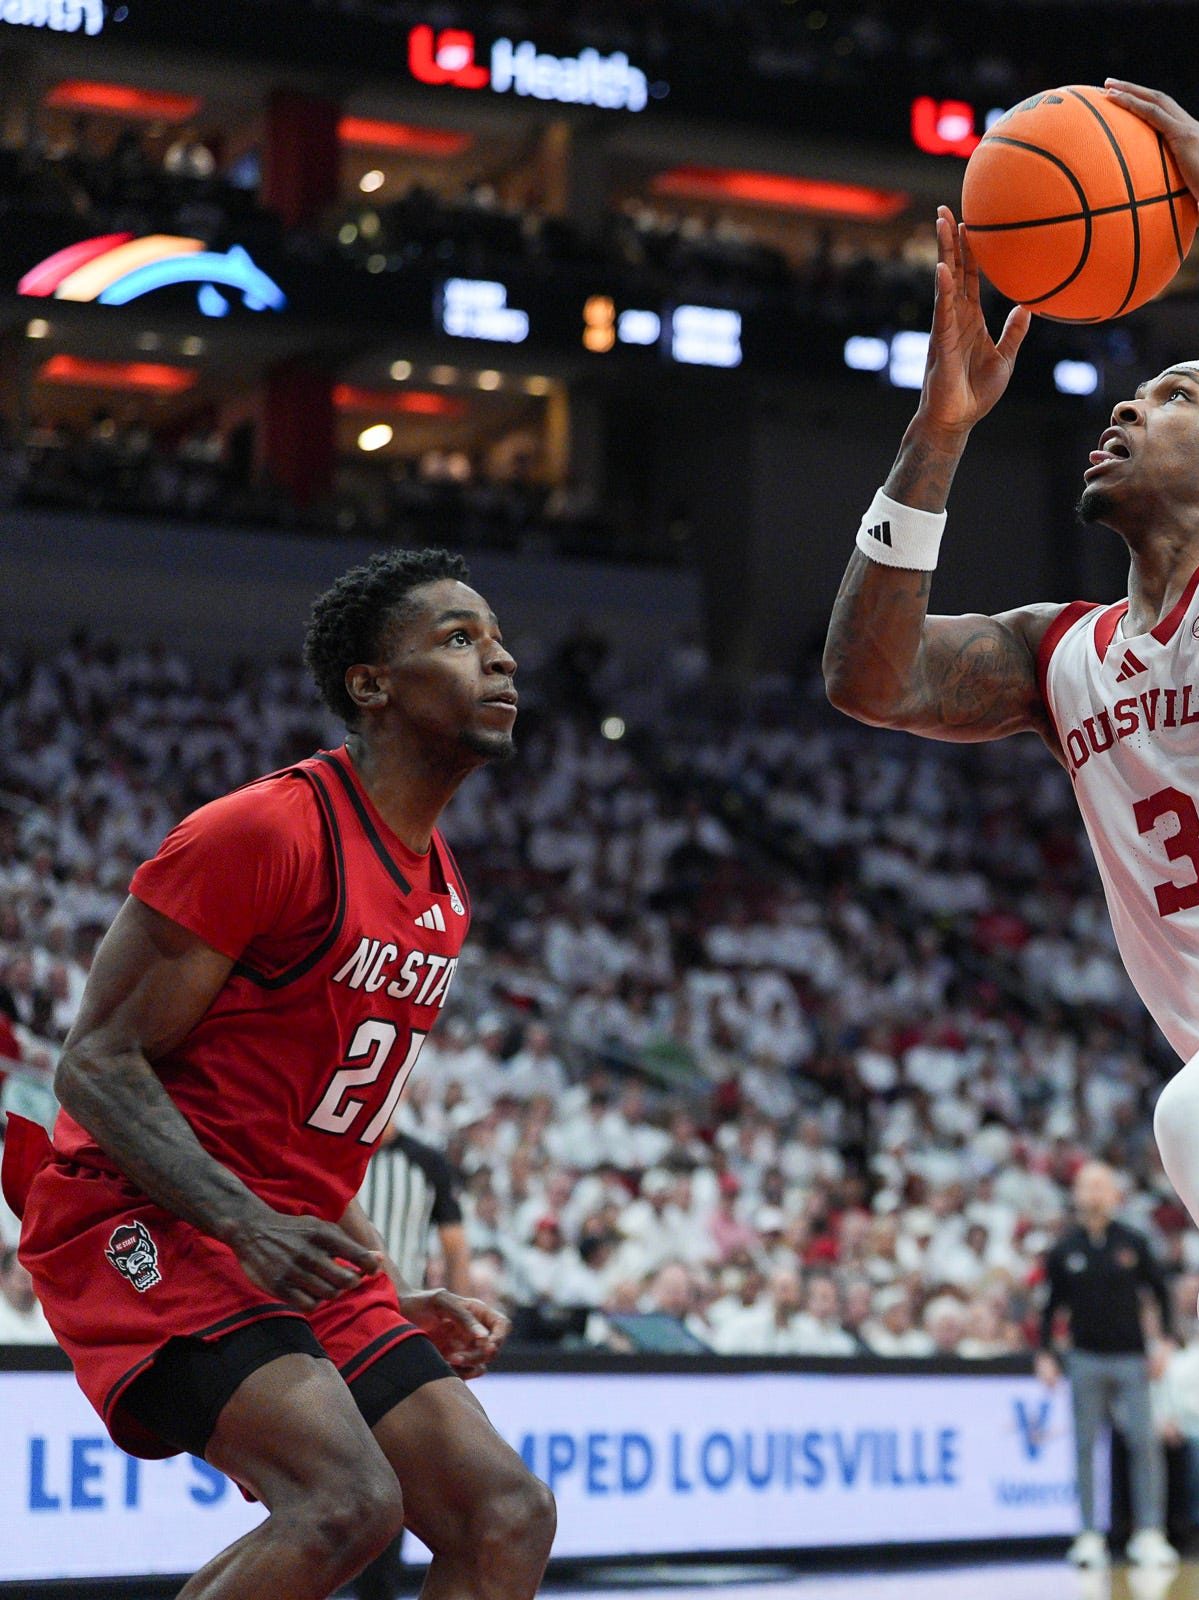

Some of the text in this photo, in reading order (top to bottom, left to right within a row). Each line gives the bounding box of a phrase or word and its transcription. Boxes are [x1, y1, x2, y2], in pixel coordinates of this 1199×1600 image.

[491, 37, 648, 112] Health
[333, 937, 398, 993] NC
[30, 1437, 228, 1506] LETS
[671, 1427, 957, 1491] LOUISVILLE
